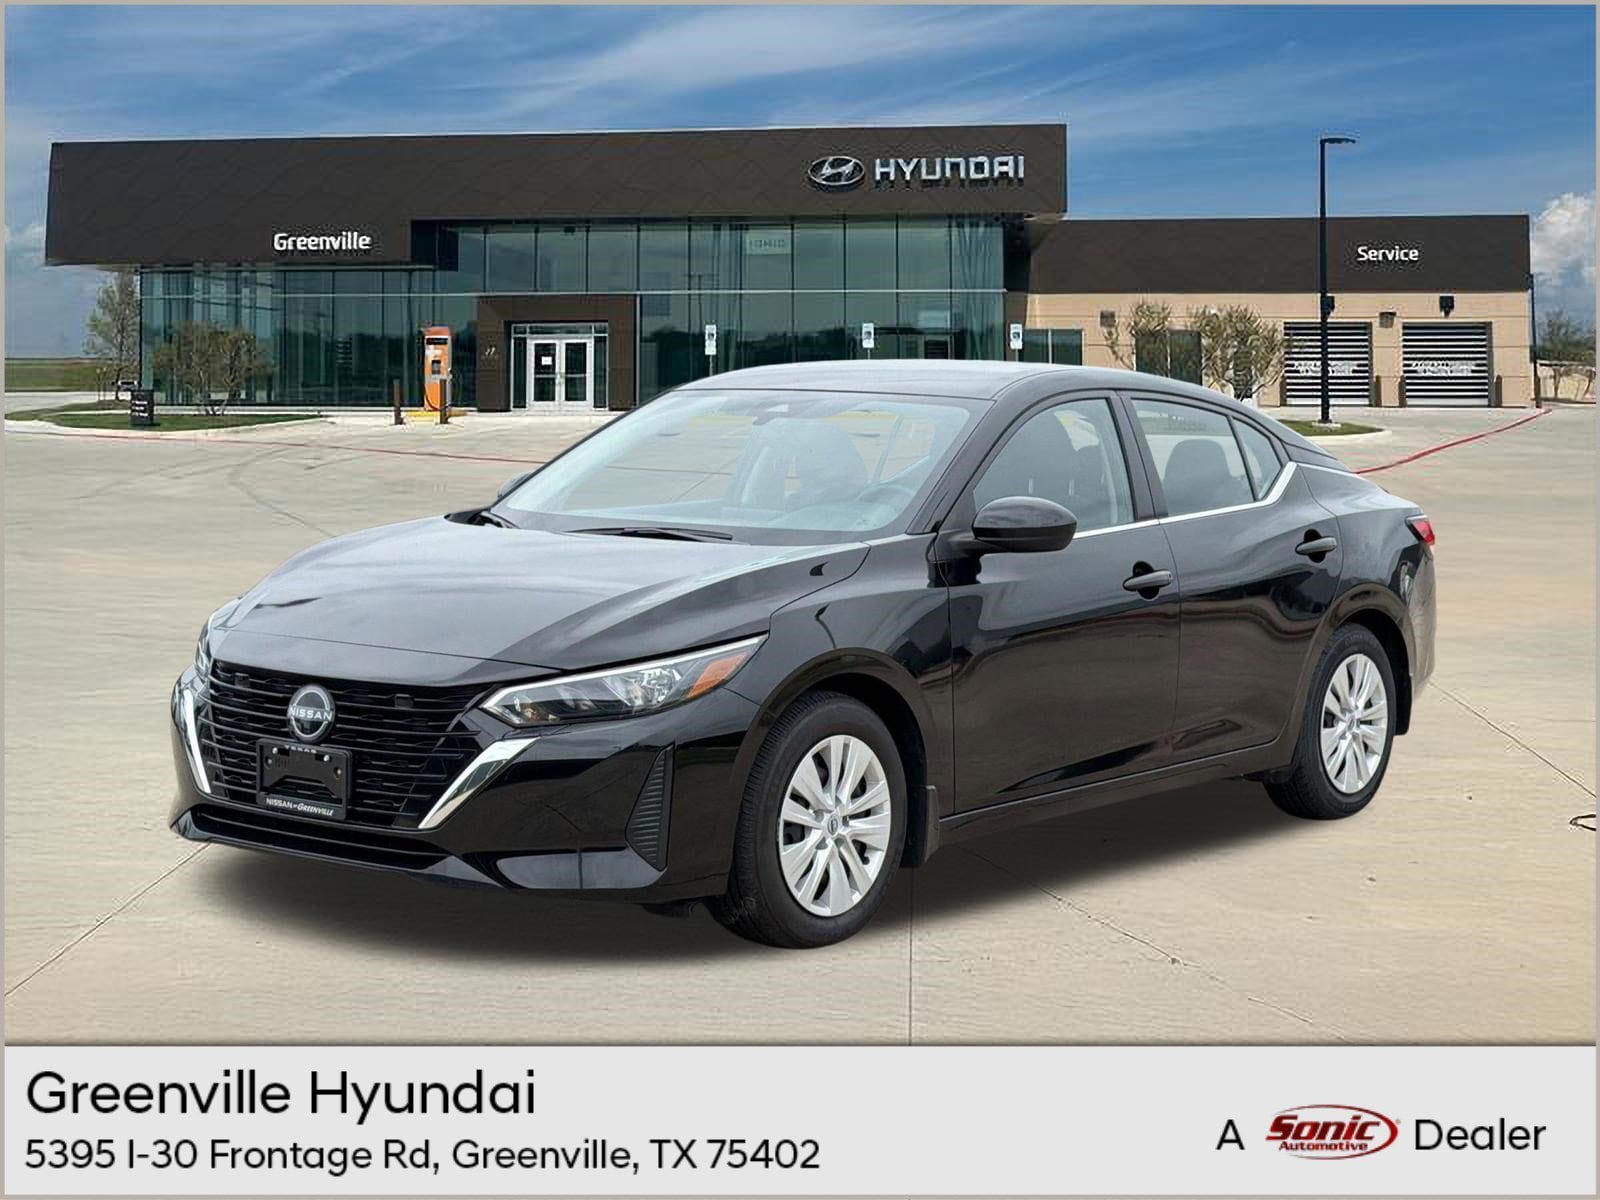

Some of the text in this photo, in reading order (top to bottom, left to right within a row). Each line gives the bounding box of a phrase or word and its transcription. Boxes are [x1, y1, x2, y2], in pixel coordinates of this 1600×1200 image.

[875, 155, 1025, 181] HYUNDAI
[273, 231, 372, 251] Greenville
[1356, 245, 1420, 262] Service
[288, 706, 333, 721] NISSAN
[266, 797, 293, 809] NISSAN
